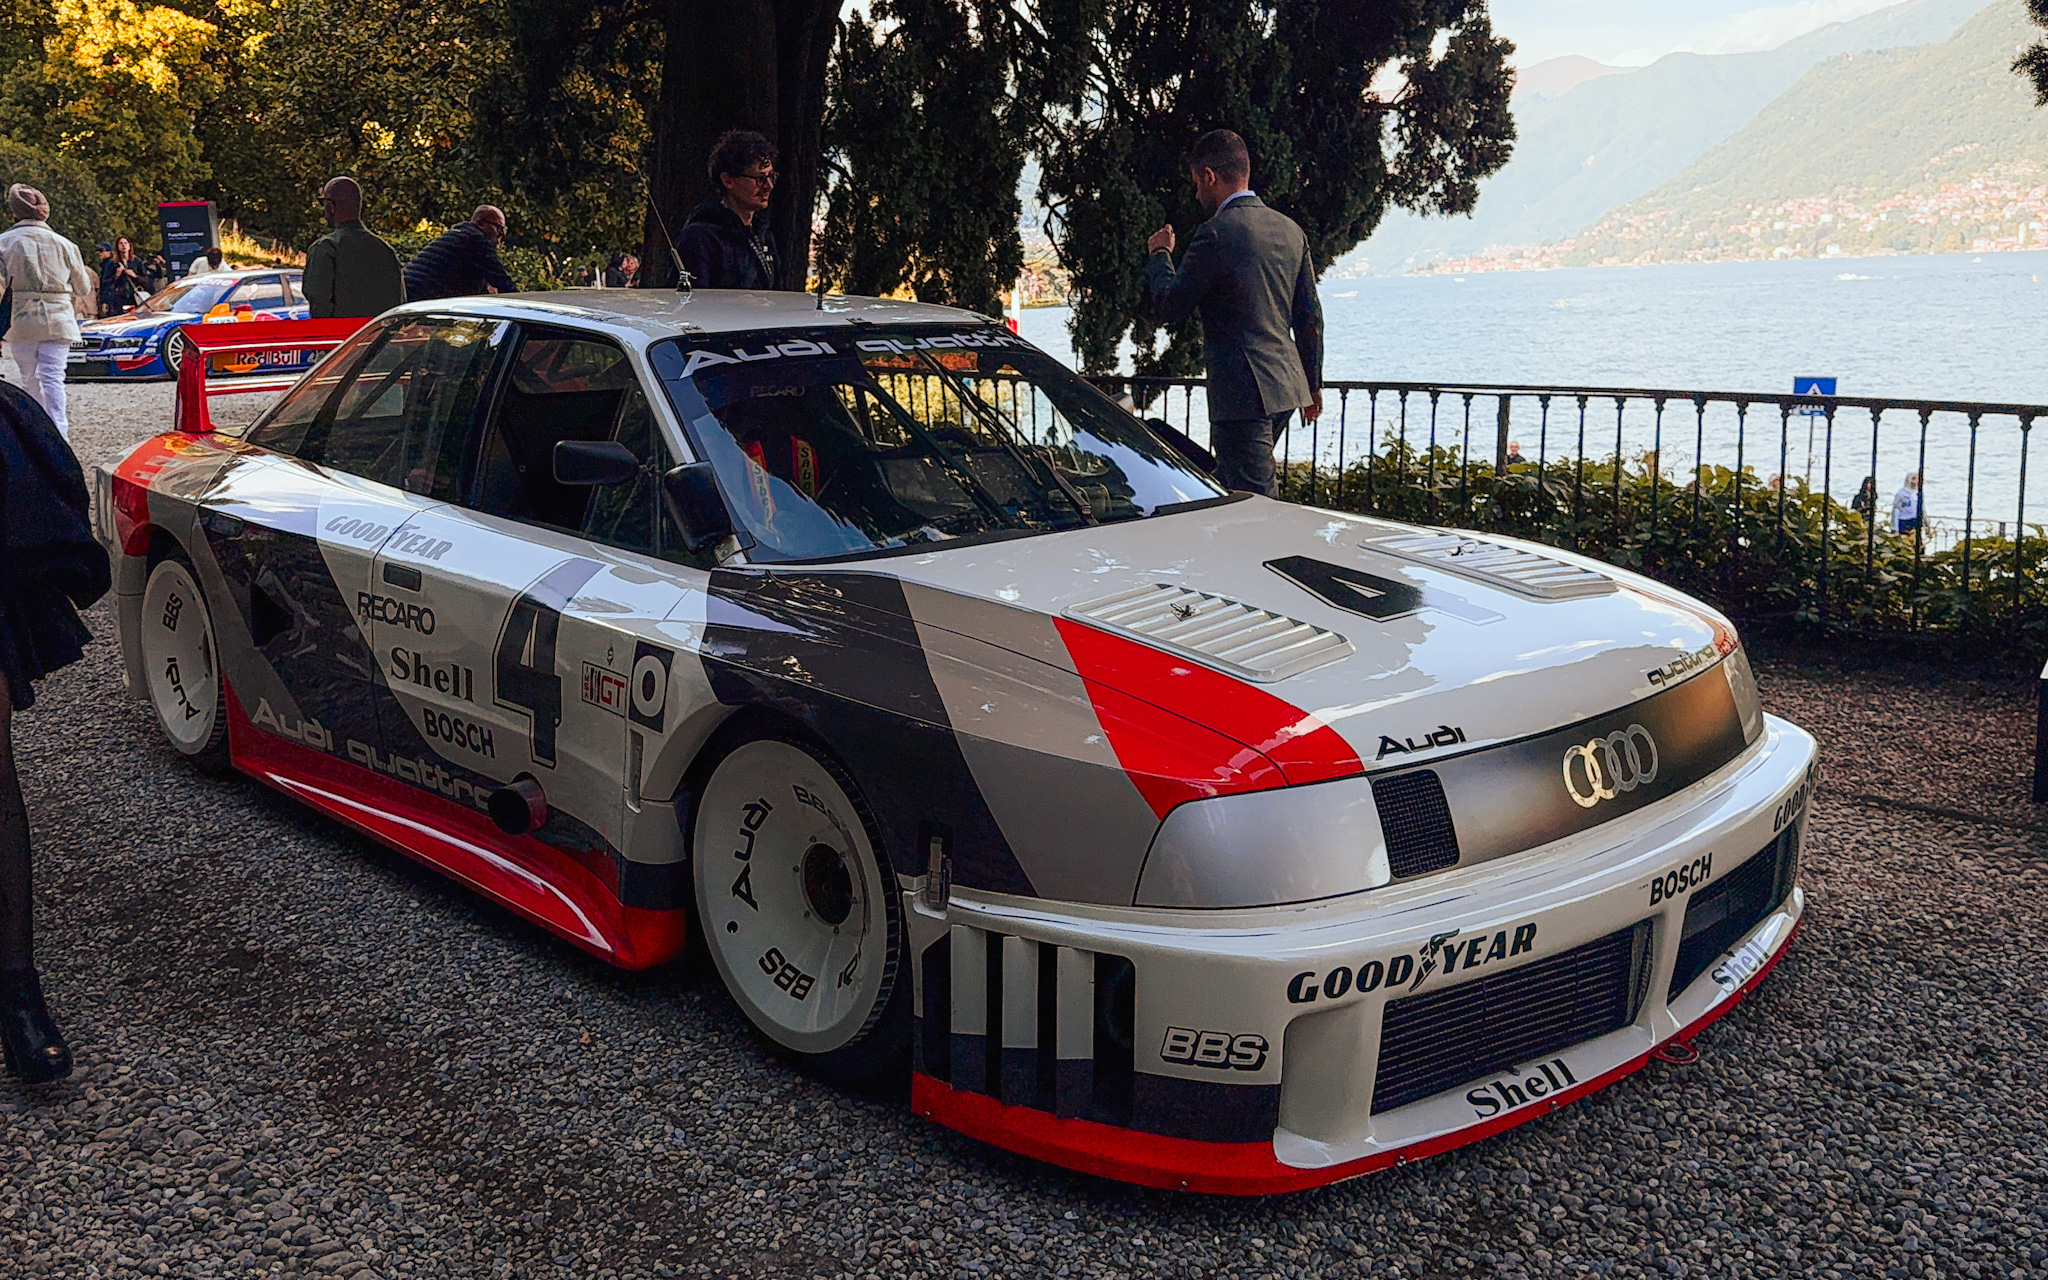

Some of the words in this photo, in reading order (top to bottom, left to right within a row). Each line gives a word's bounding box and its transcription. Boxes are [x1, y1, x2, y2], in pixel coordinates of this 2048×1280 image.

[679, 340, 838, 379] Audi
[855, 334, 1038, 355] quattro
[162, 593, 185, 633] BBS
[357, 591, 436, 636] RECARO
[166, 657, 201, 721] Audi
[390, 646, 475, 703] Shell
[492, 557, 606, 770] 4
[1646, 644, 1717, 687] quattro
[600, 675, 626, 709] GT
[250, 696, 335, 752] Audi
[422, 710, 496, 759] BOSCH
[1375, 724, 1467, 761] Audi
[731, 796, 775, 914] Audi
[1649, 851, 1713, 908] BOSCH
[758, 946, 817, 1002] BBS
[1711, 938, 1771, 994] Shell
[1159, 1026, 1270, 1072] BBS
[1465, 1058, 1579, 1120] Shell
